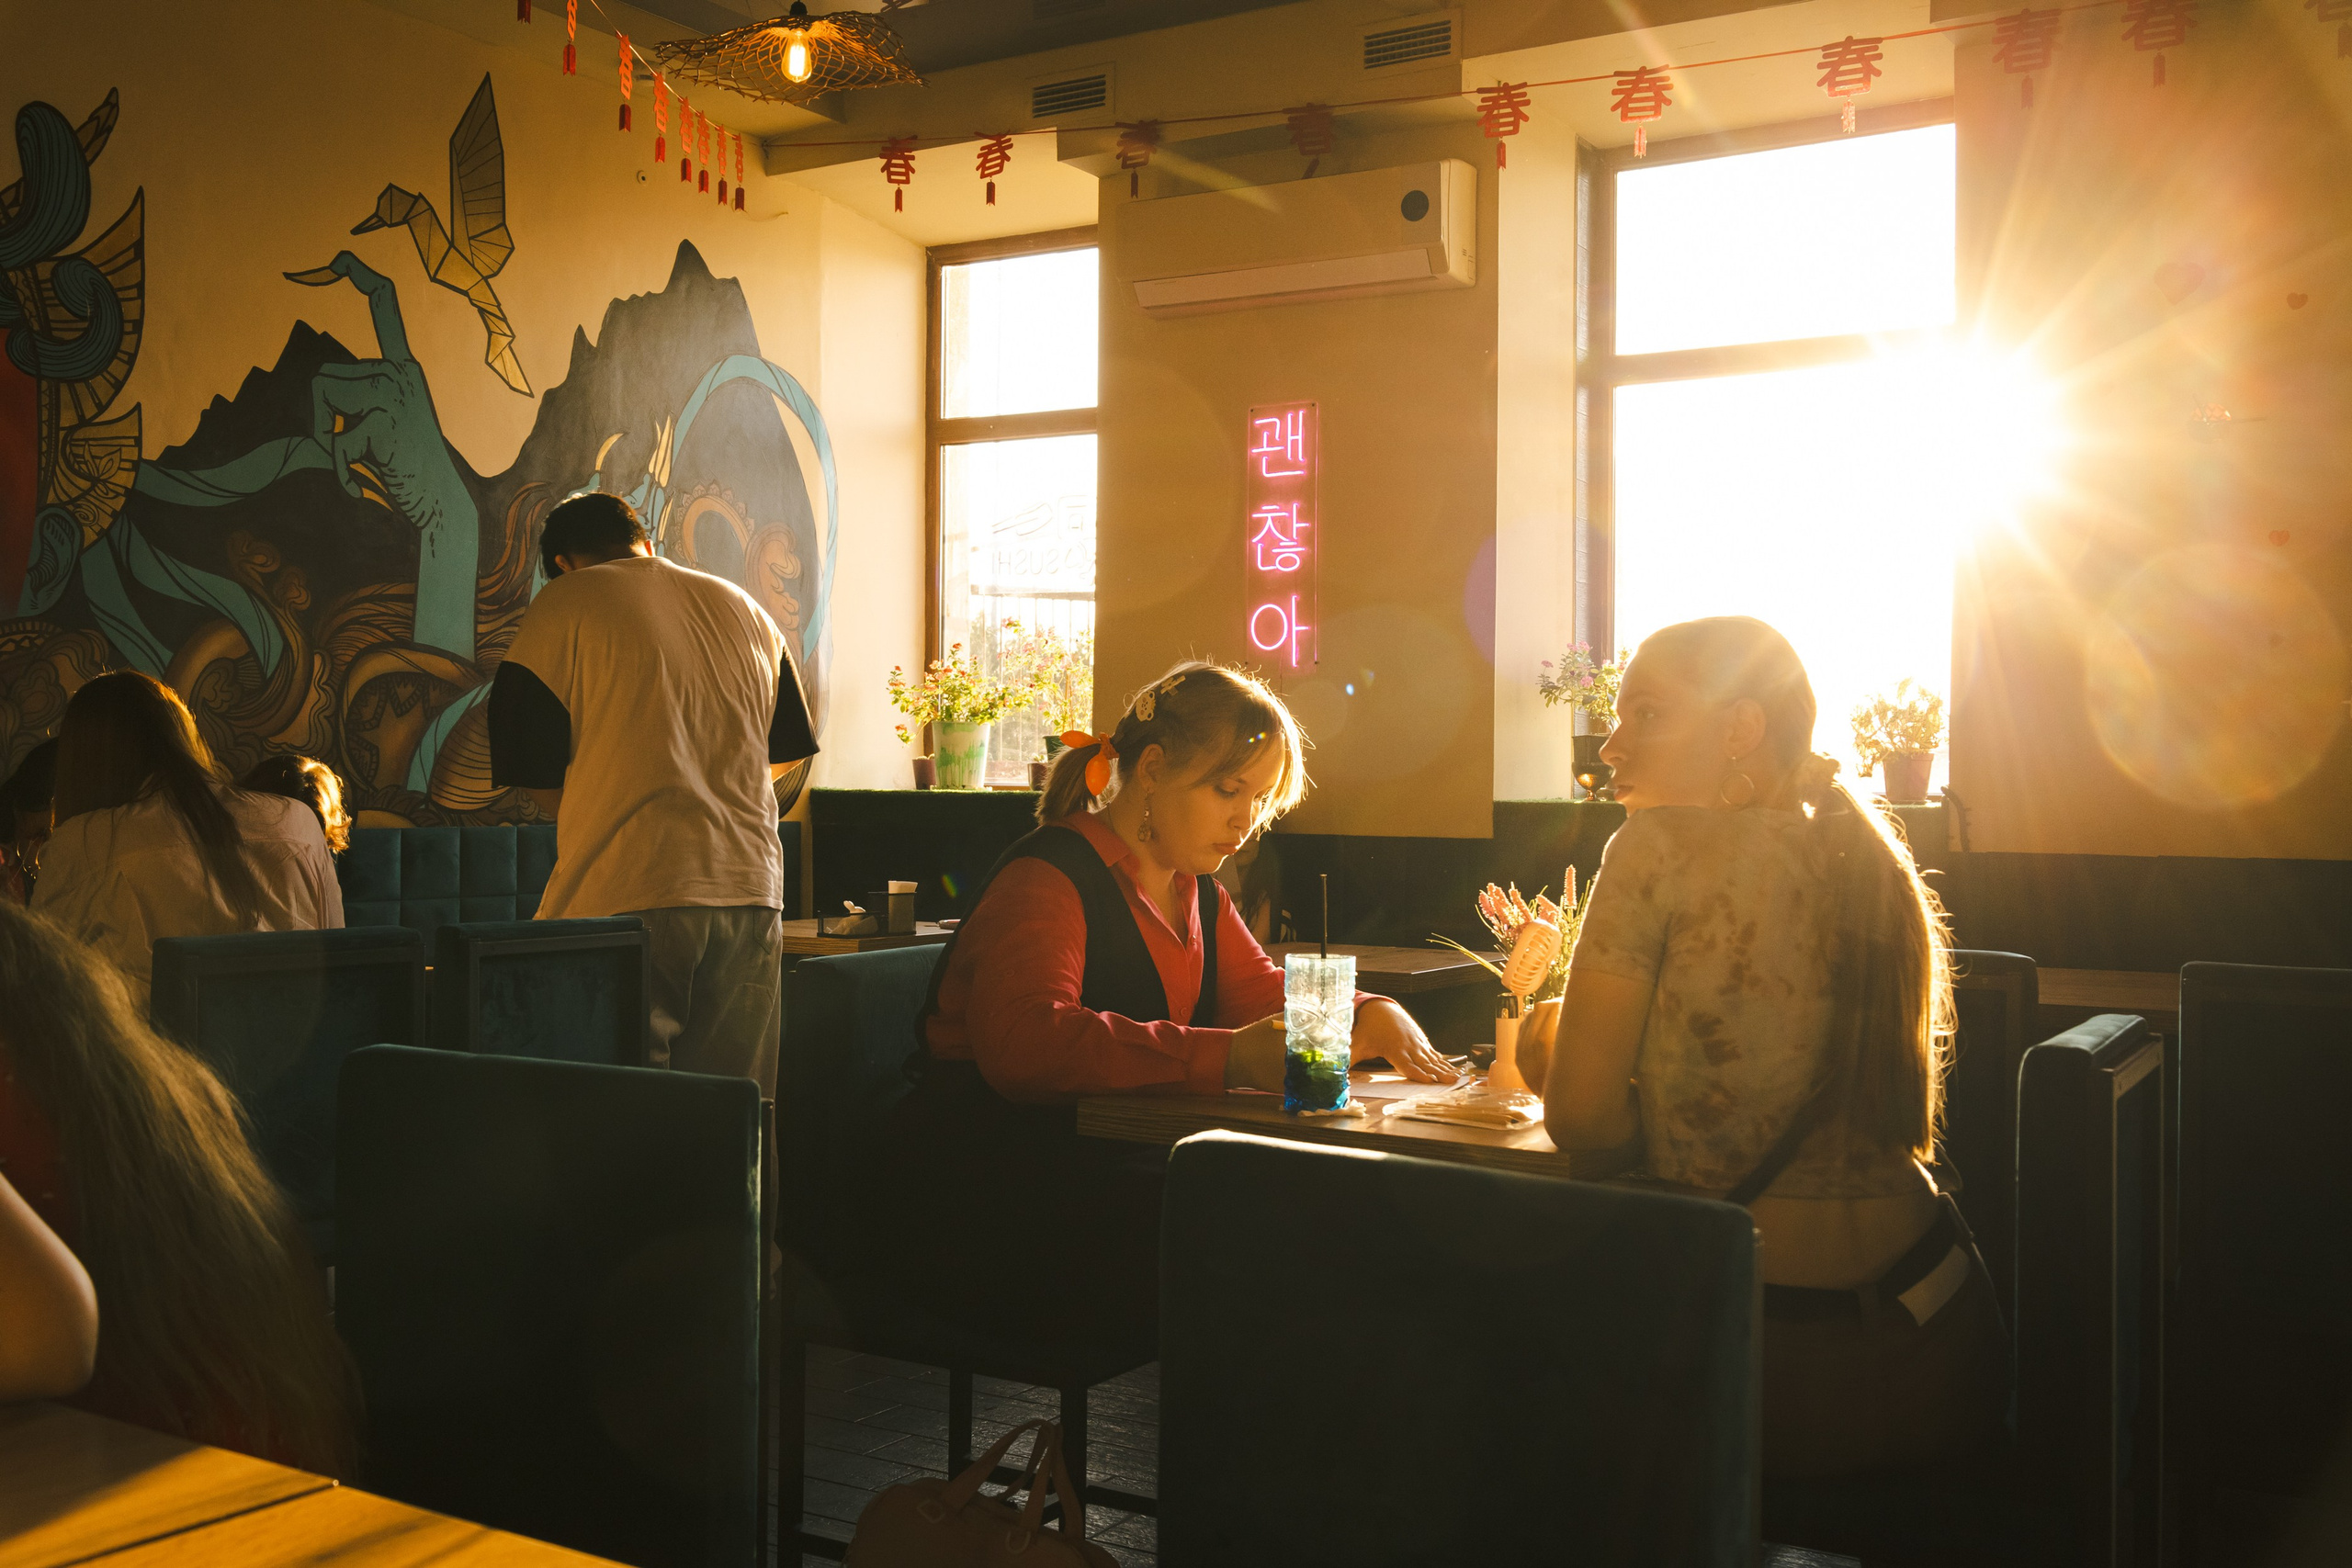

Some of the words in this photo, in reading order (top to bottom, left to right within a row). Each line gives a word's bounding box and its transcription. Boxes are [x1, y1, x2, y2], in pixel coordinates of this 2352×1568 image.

[1816, 35, 1883, 97] 春
[1992, 8, 2063, 73] 春
[1476, 82, 1532, 138] 春
[1611, 64, 1674, 123] 春
[879, 135, 918, 185] 春
[974, 130, 1013, 179] 春
[1250, 410, 1310, 668] 괜찮아
